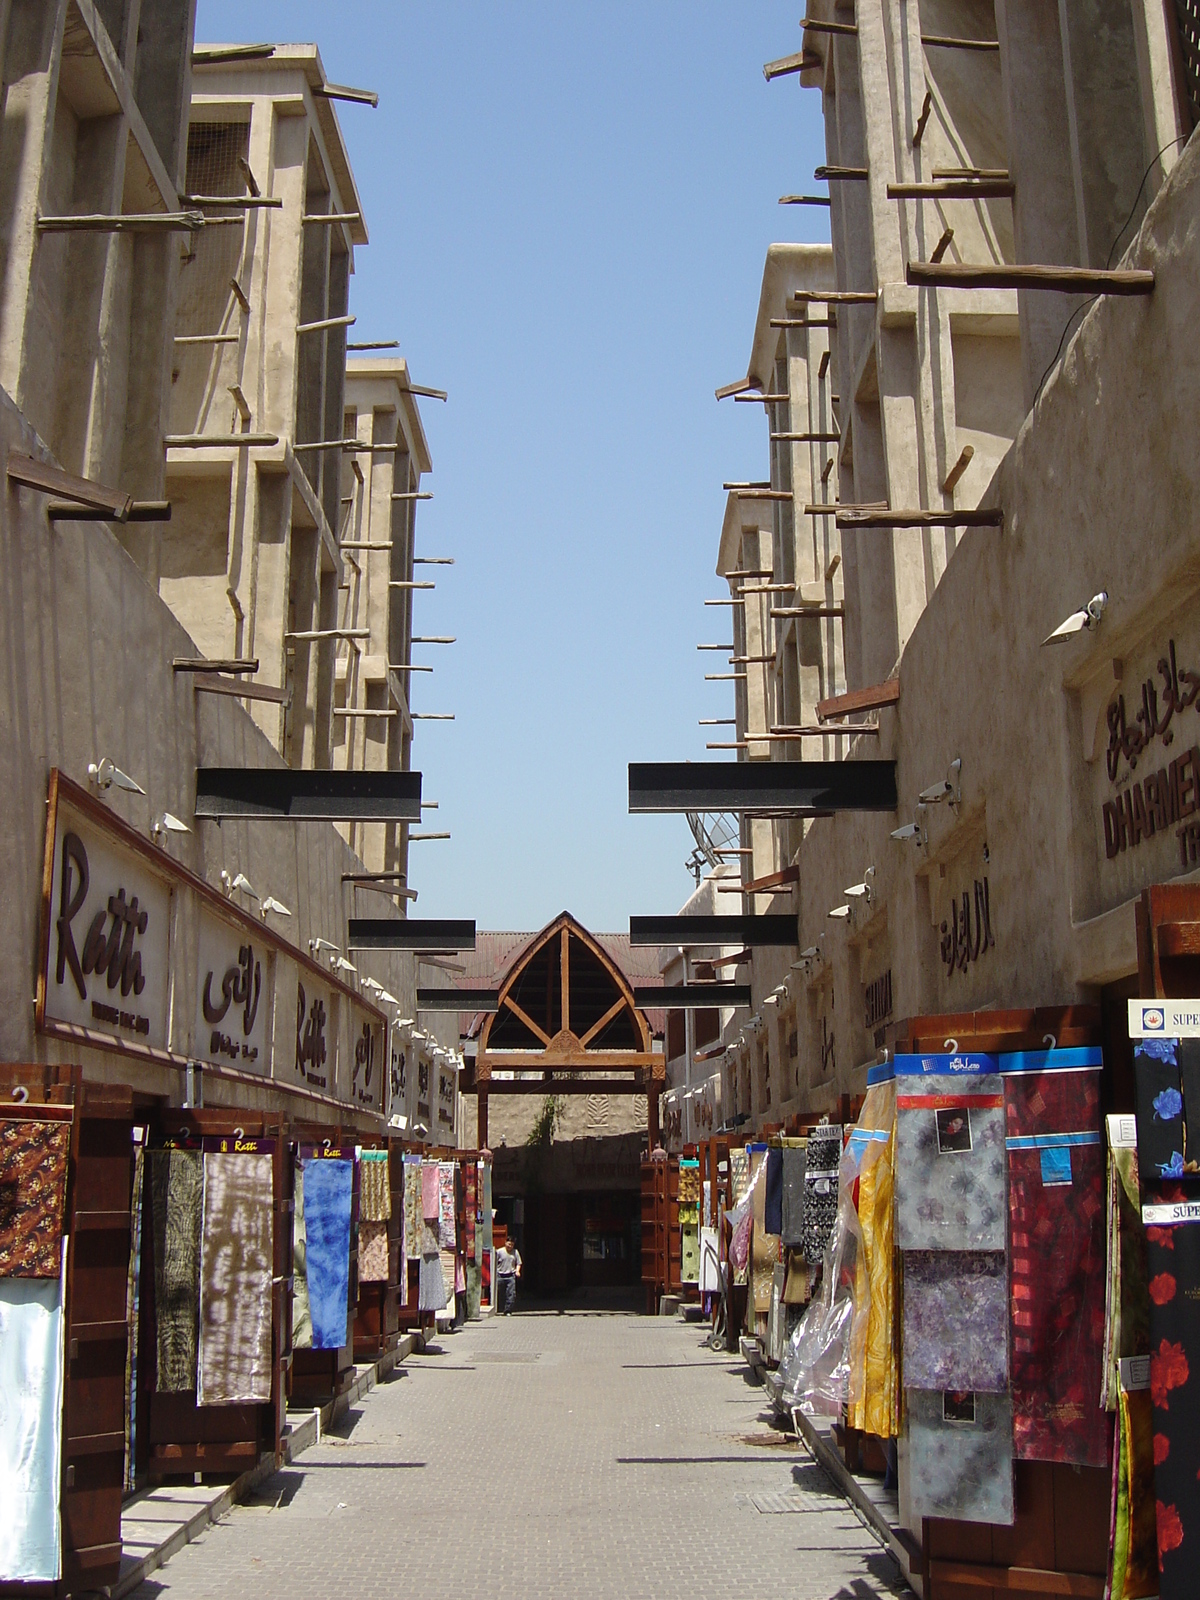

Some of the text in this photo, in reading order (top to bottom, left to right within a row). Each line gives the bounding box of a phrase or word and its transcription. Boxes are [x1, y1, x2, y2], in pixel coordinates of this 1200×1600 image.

[56, 832, 148, 1000] Ratti
[1172, 1013, 1200, 1026] SUPE
[294, 981, 327, 1077] Ratti
[234, 1140, 258, 1152] Ratti
[323, 1148, 342, 1158] Ratti
